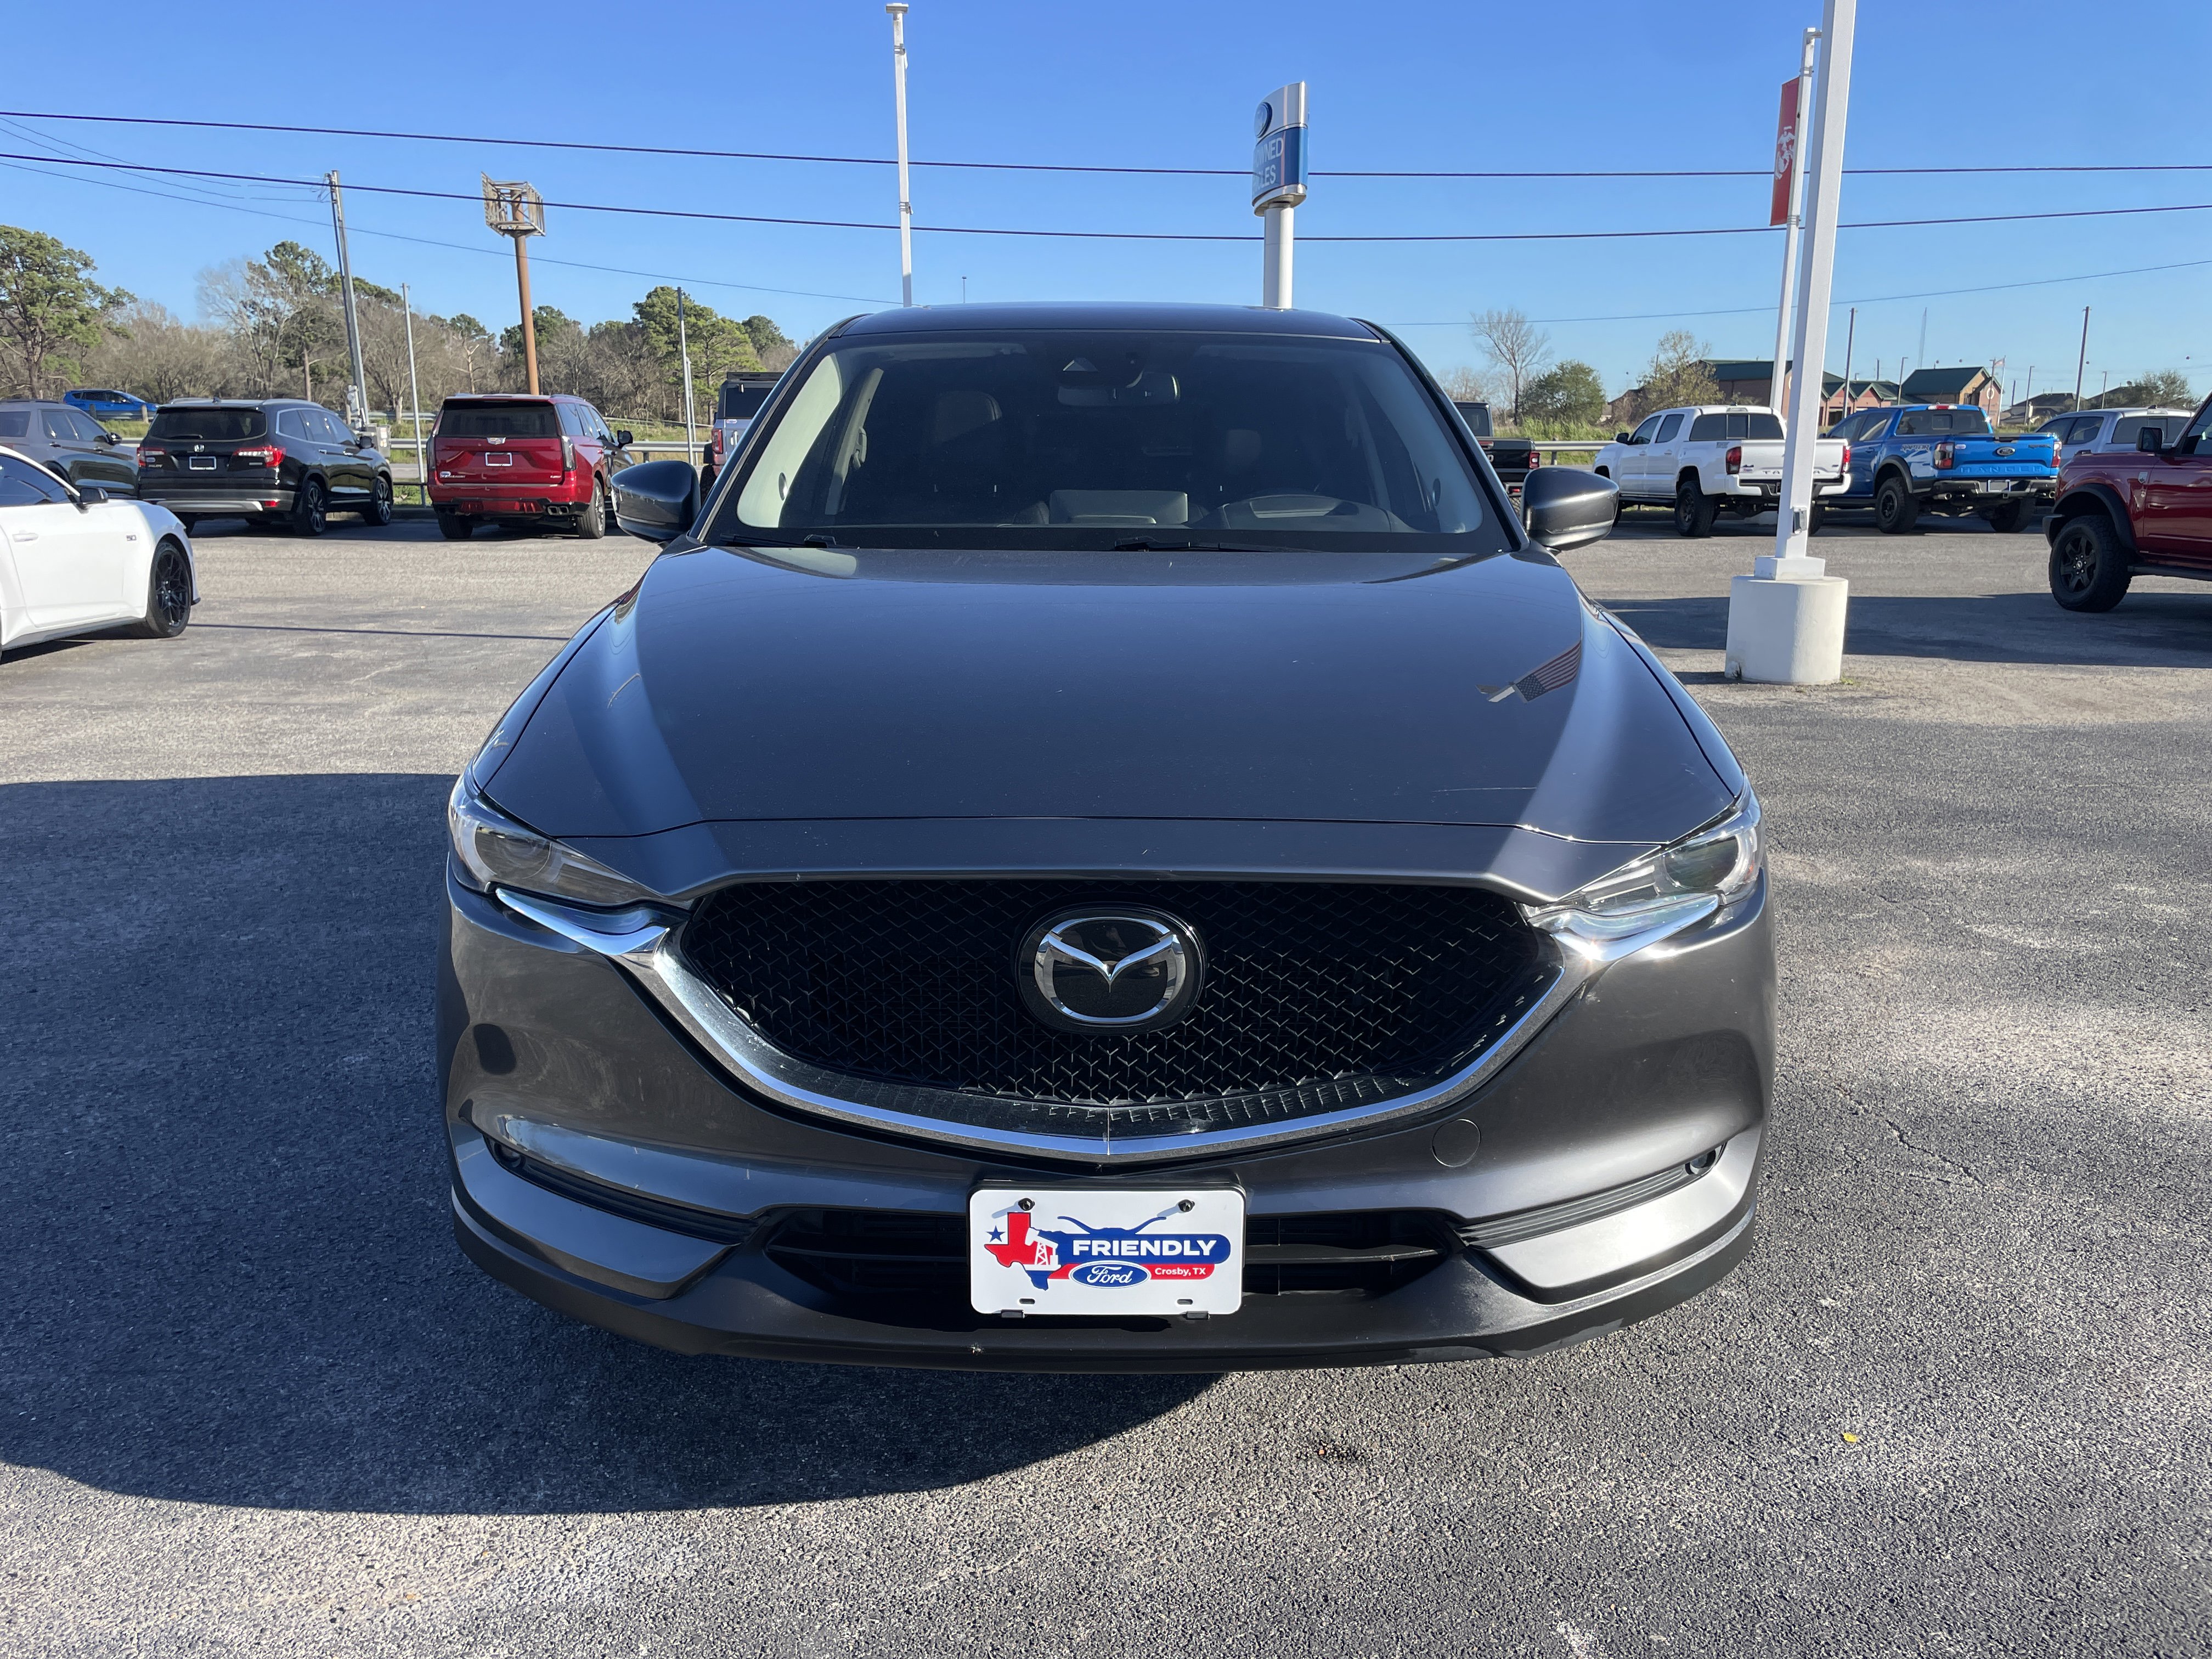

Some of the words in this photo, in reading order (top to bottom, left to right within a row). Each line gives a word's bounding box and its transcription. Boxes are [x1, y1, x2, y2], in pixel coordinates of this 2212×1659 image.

[1073, 1240, 1217, 1256] FRIENDLY
[1086, 1265, 1133, 1284] Ford
[1154, 1267, 1192, 1277] Crosby,
[1193, 1267, 1206, 1276] TX
